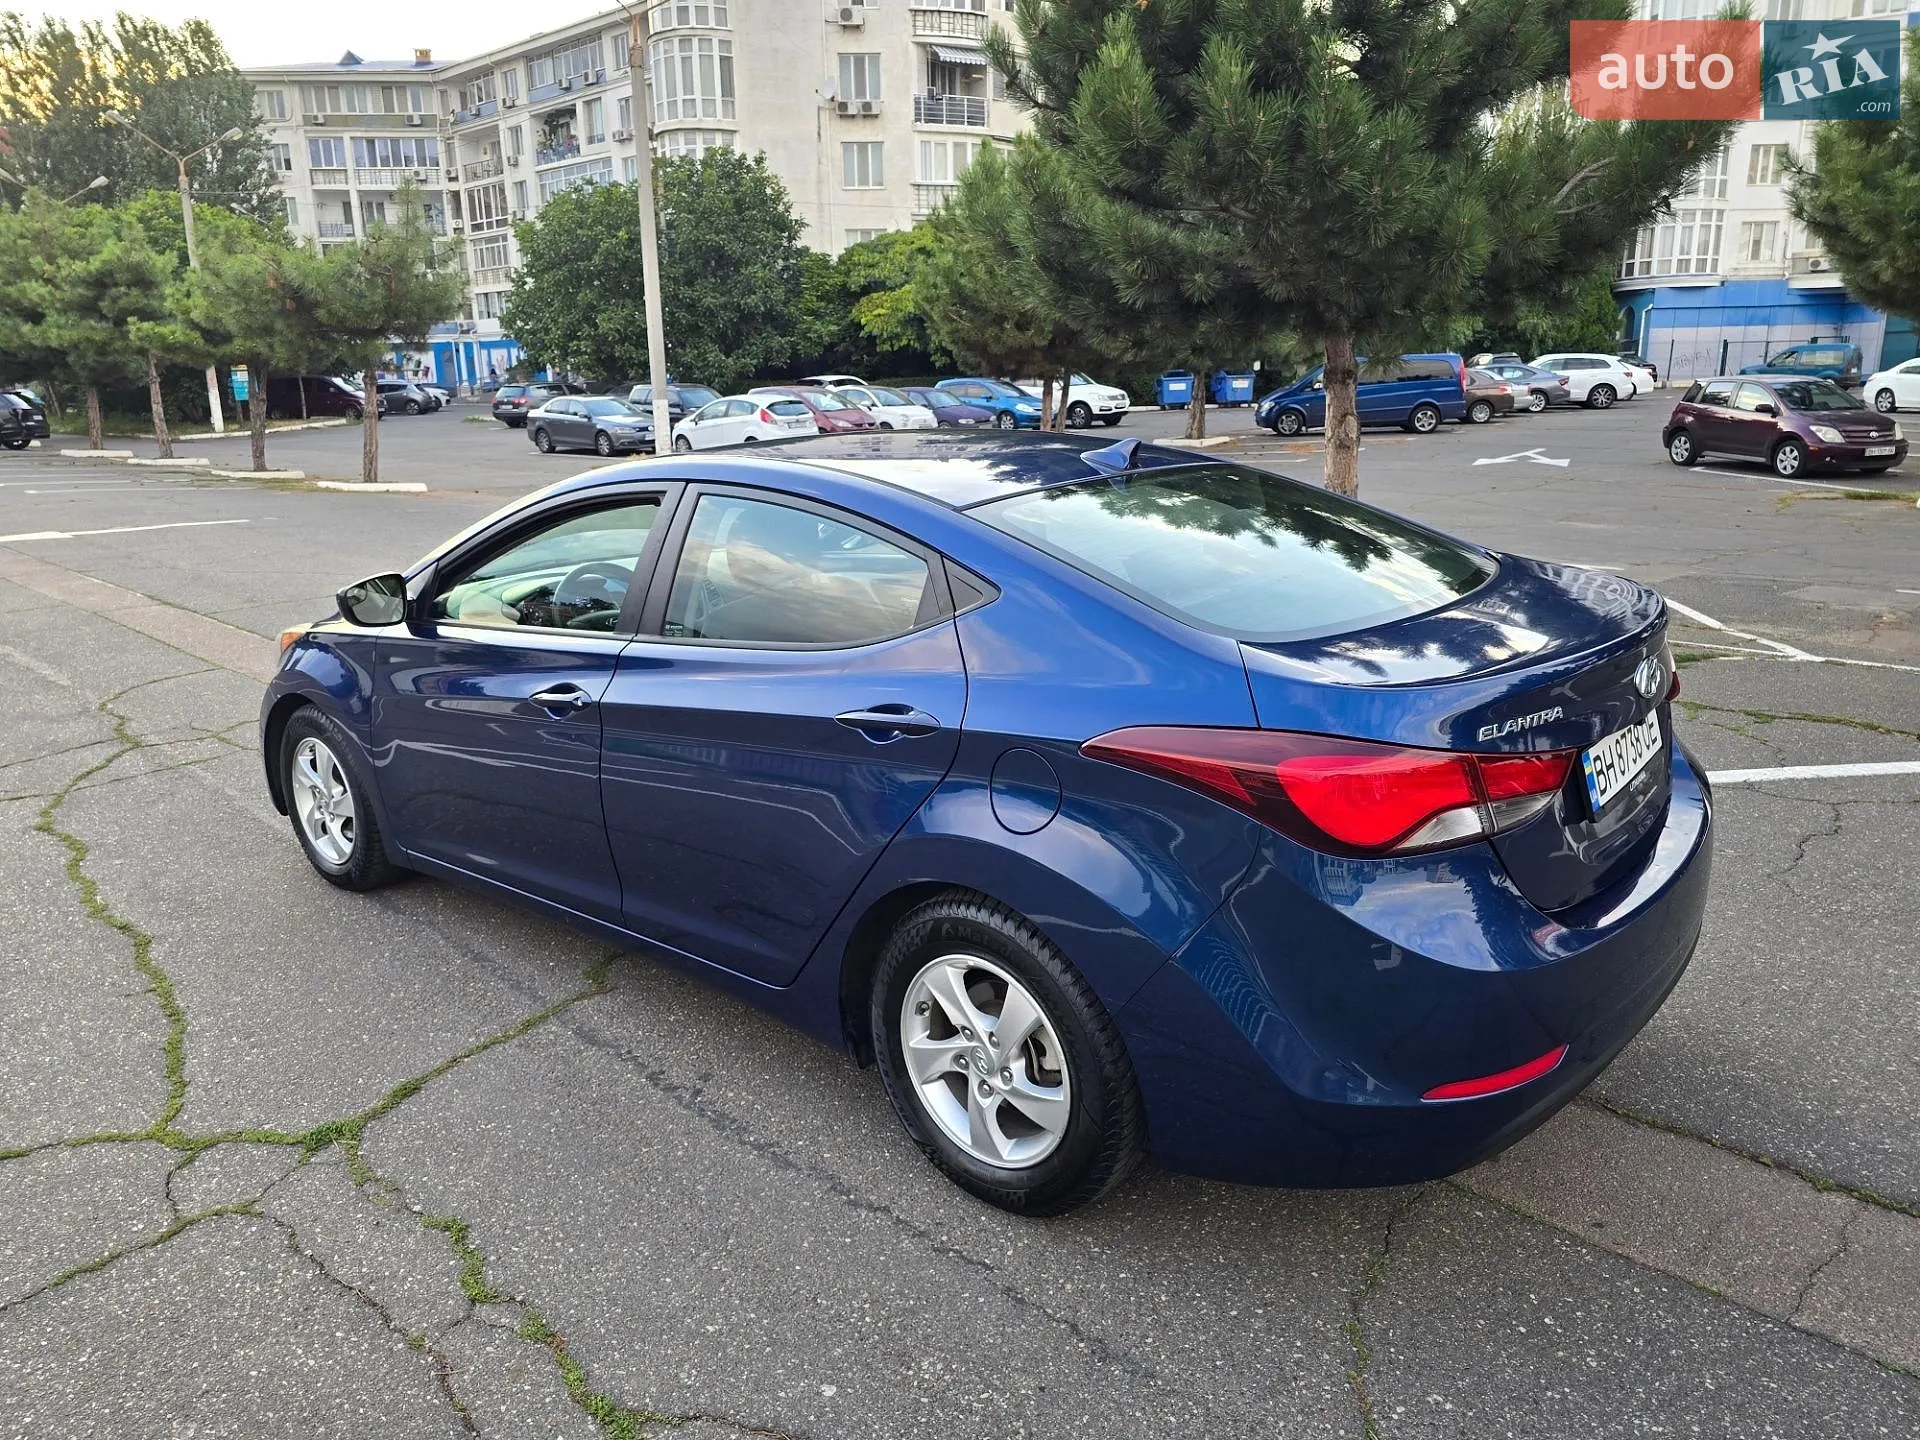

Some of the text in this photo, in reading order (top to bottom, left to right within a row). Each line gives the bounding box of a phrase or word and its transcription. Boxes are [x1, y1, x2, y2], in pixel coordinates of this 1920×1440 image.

[1477, 705, 1564, 742] ELANTRA
[1593, 744, 1618, 797] BH
[1615, 725, 1643, 777] 8738
